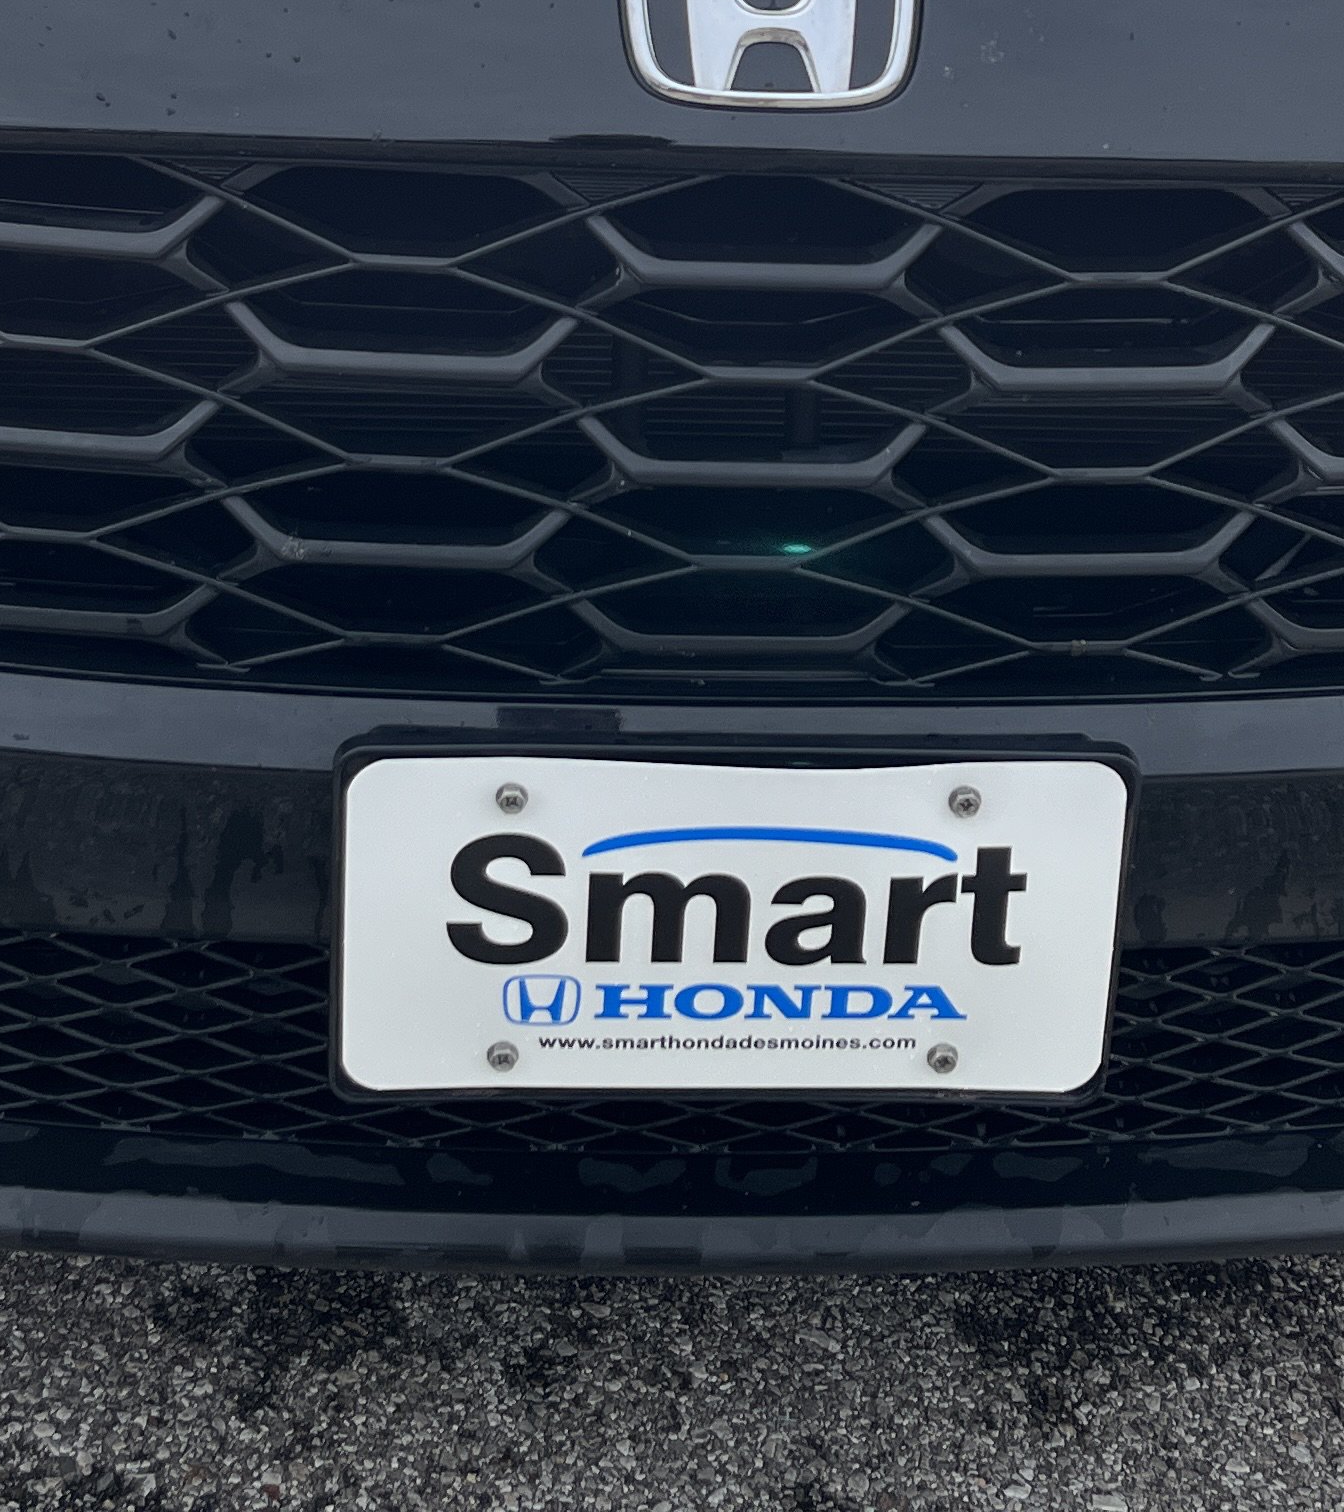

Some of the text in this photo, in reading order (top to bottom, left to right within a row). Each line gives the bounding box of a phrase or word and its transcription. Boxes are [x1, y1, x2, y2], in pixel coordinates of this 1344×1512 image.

[446, 832, 1027, 967] Smart
[594, 983, 967, 1022] HONDA
[538, 1034, 917, 1051] www.smarthondadesmoines.com
